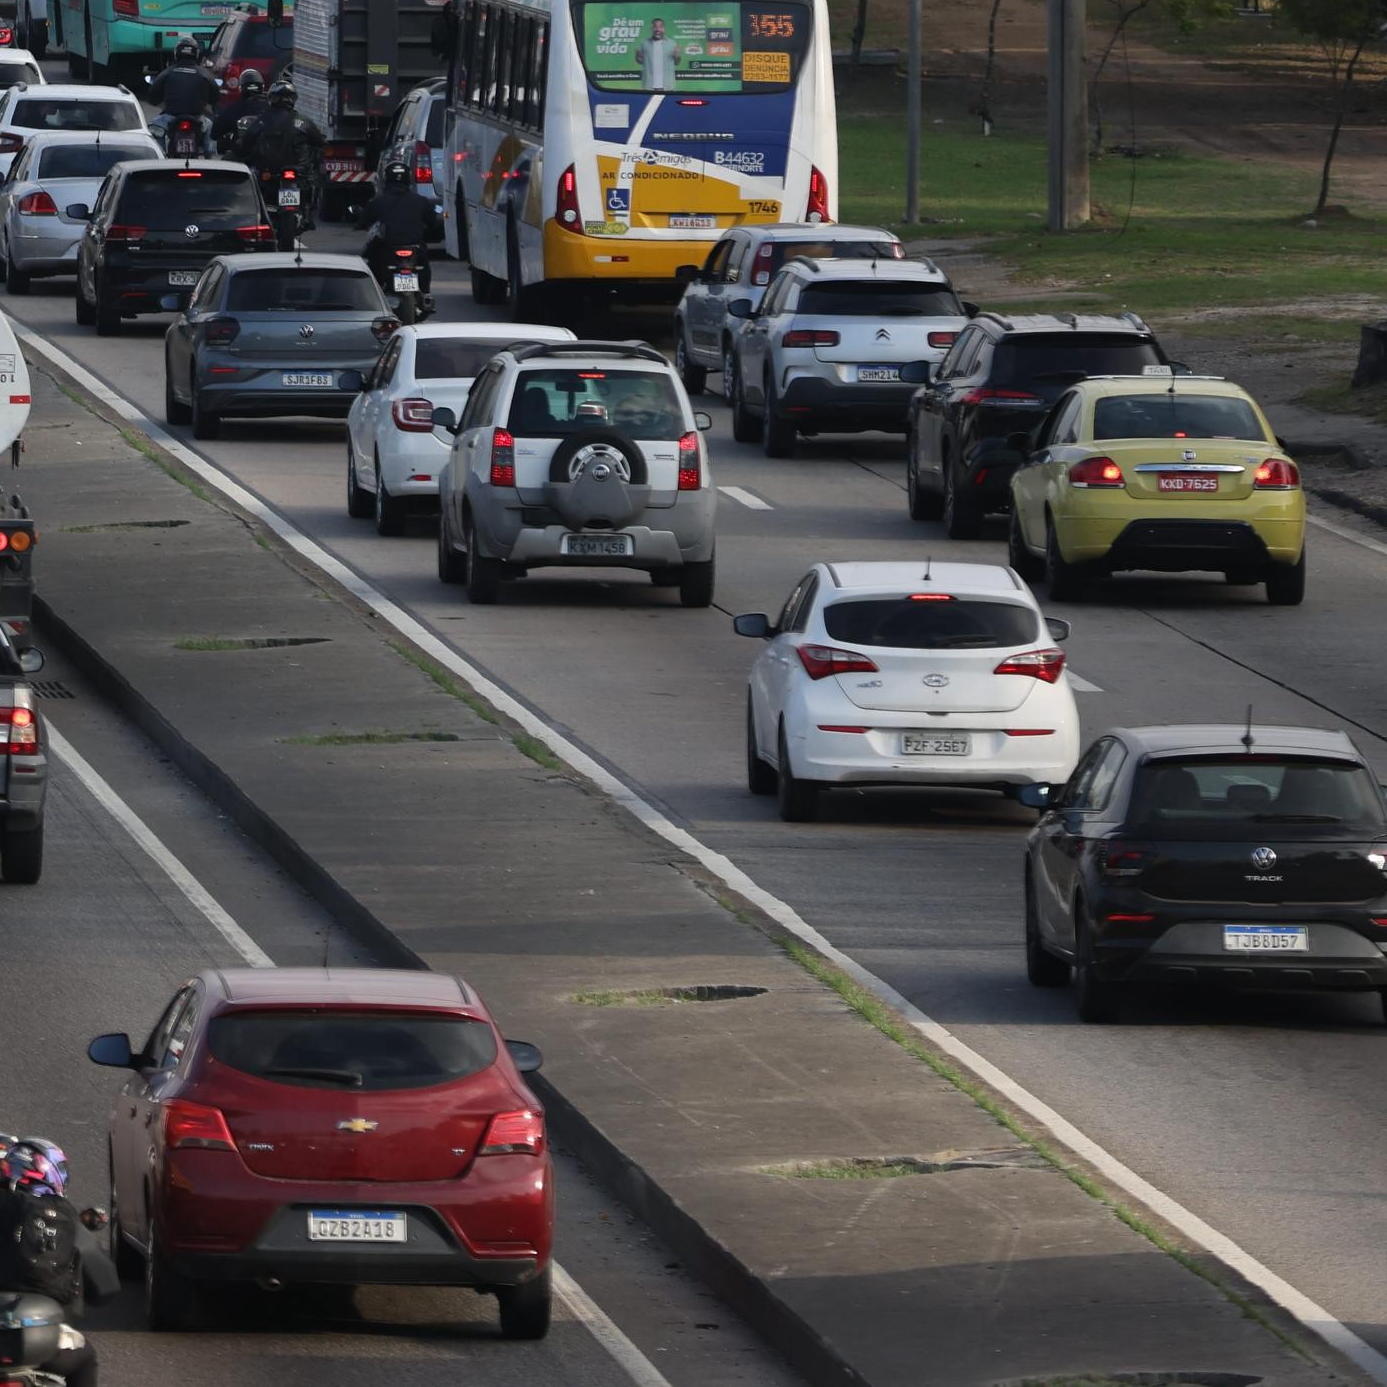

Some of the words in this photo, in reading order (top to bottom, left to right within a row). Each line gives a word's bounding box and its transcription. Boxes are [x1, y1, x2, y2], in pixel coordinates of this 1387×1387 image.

[627, 19, 645, 27] um
[749, 14, 794, 37] 155
[598, 26, 642, 42] grau
[596, 42, 628, 54] vida
[744, 54, 788, 63] DISQUE
[715, 151, 765, 165] B44632
[602, 172, 616, 180] AR
[620, 172, 699, 180] CONDICIONADO
[749, 201, 778, 213] 1746
[1230, 934, 1298, 949] TJB8D57
